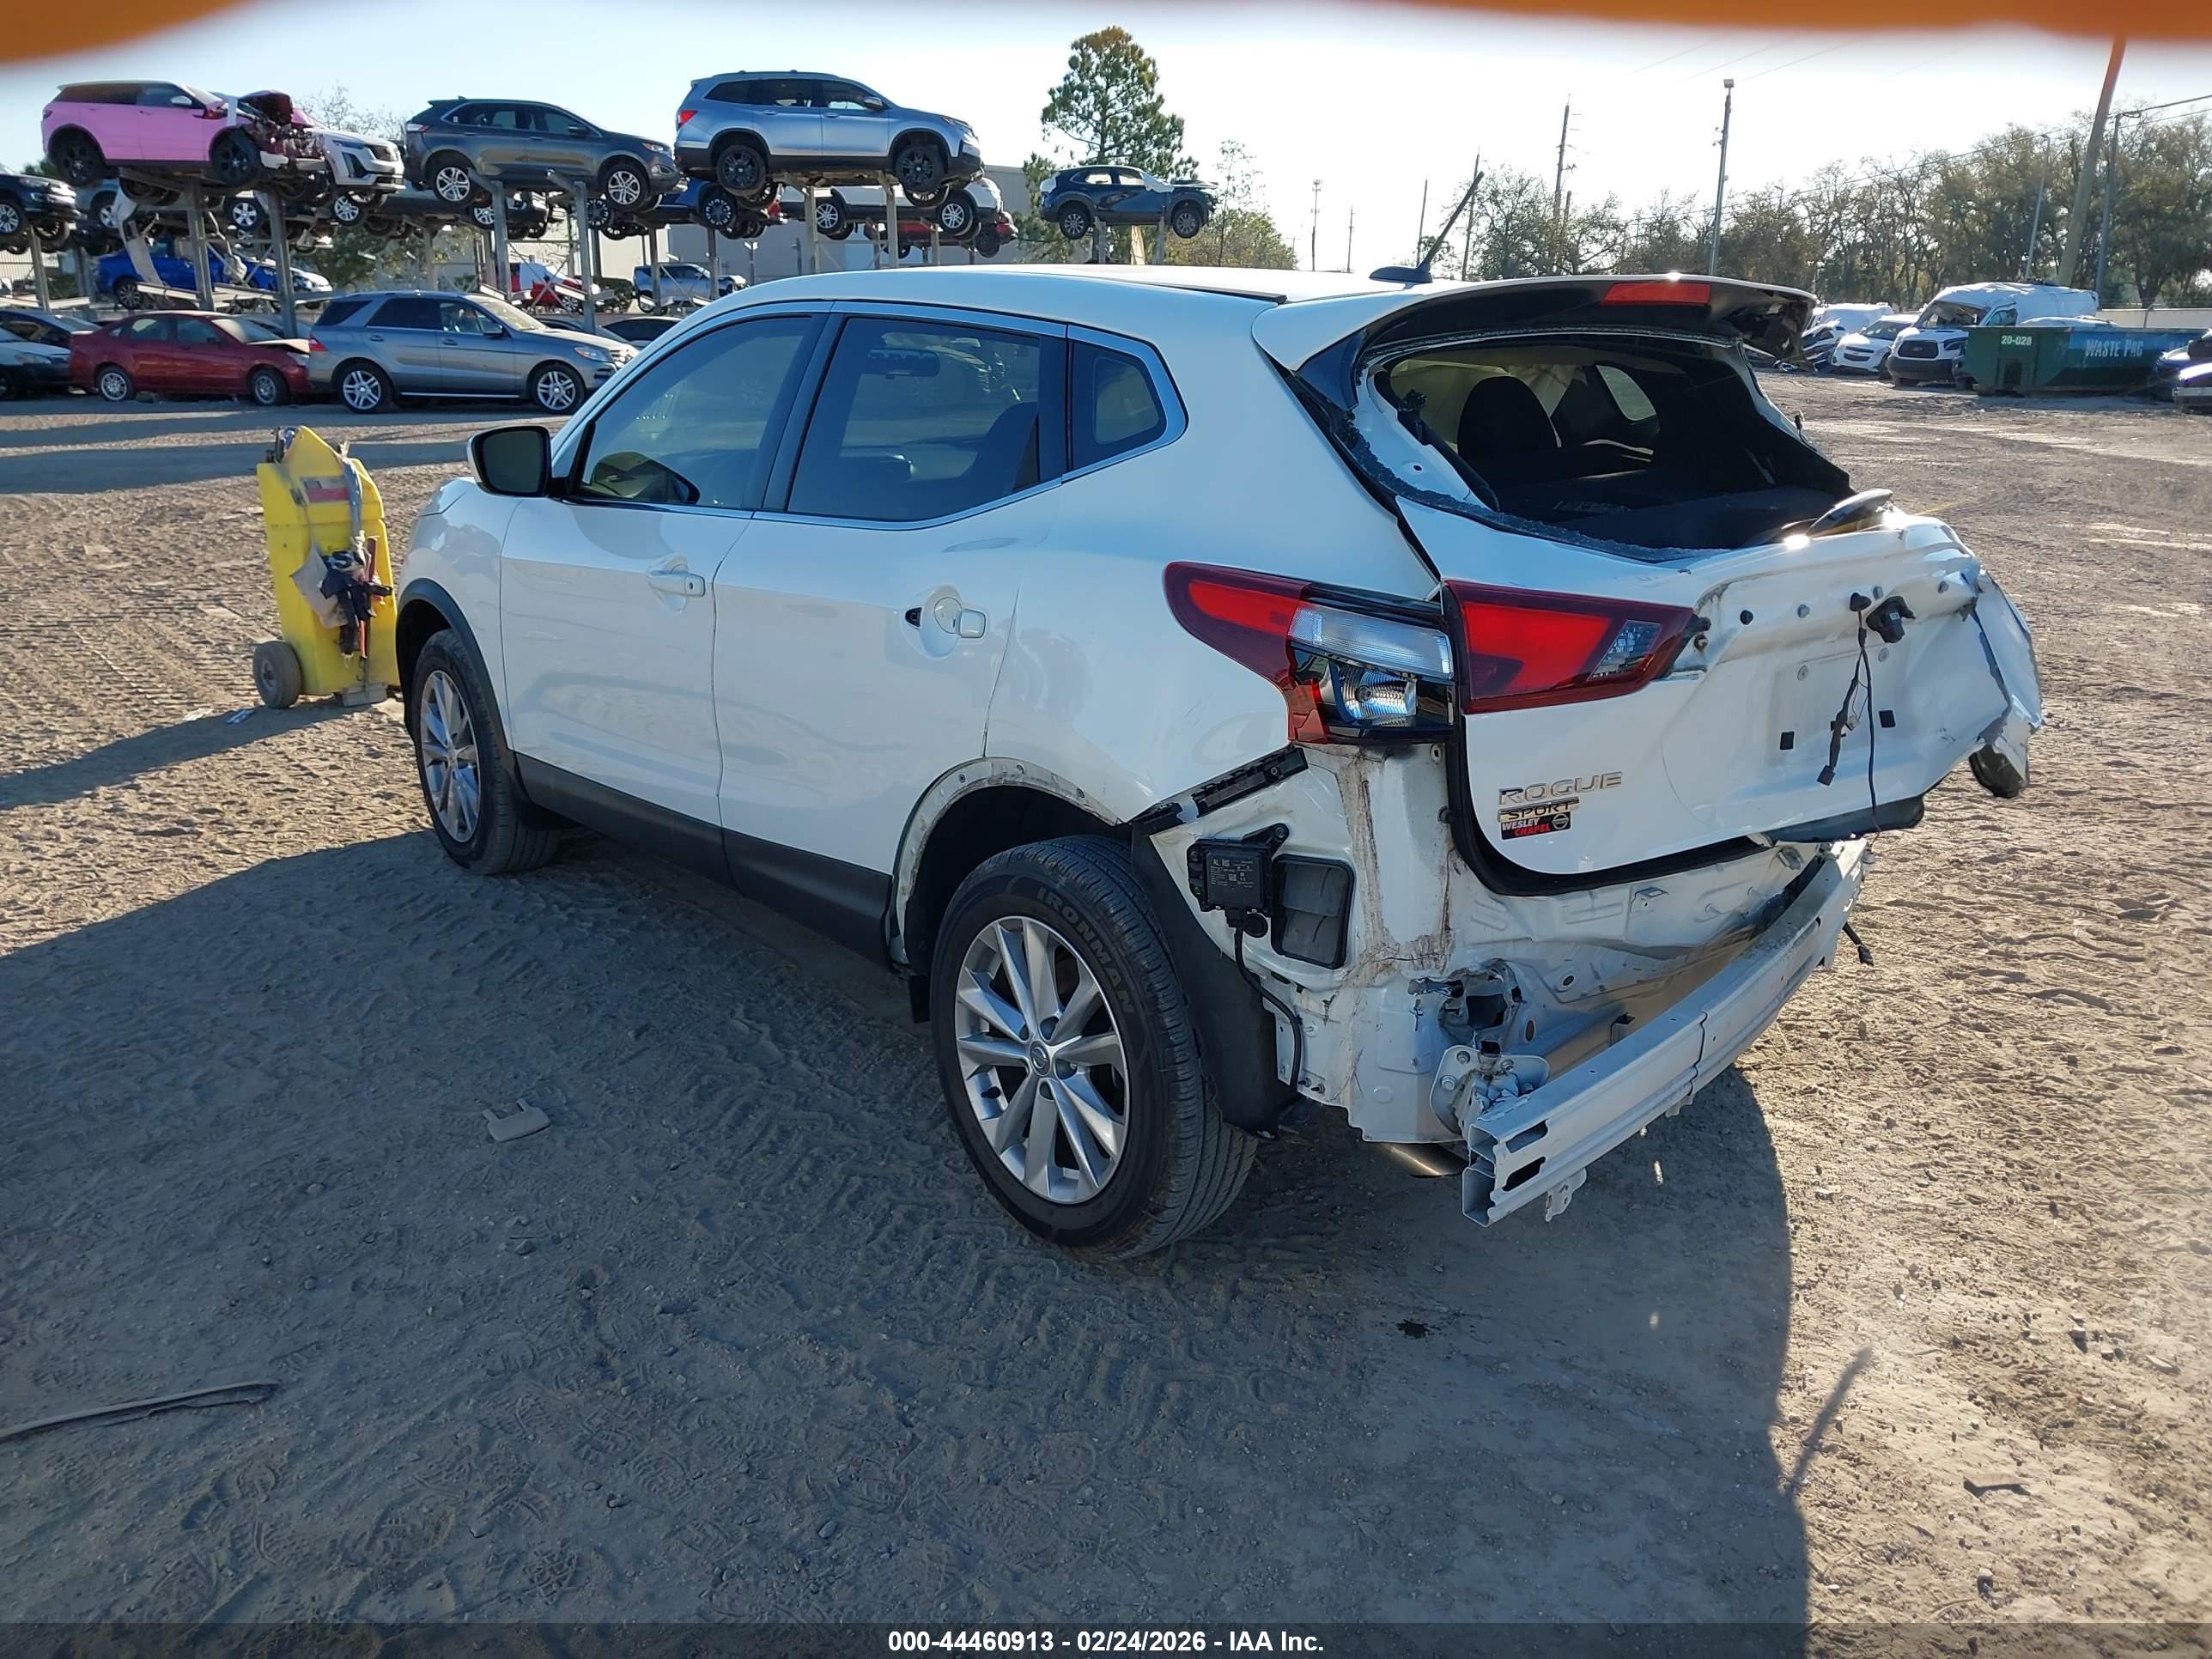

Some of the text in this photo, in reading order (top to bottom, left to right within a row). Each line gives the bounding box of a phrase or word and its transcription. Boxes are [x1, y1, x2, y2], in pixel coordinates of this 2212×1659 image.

[2085, 339, 2121, 357] WASTE
[1498, 771, 1623, 805] ROGUE
[1508, 802, 1571, 820] SPORT
[1503, 817, 1540, 830] WESLEY
[1514, 823, 1552, 837] CHAPEL
[1036, 886, 1135, 1013] IRONMAN
